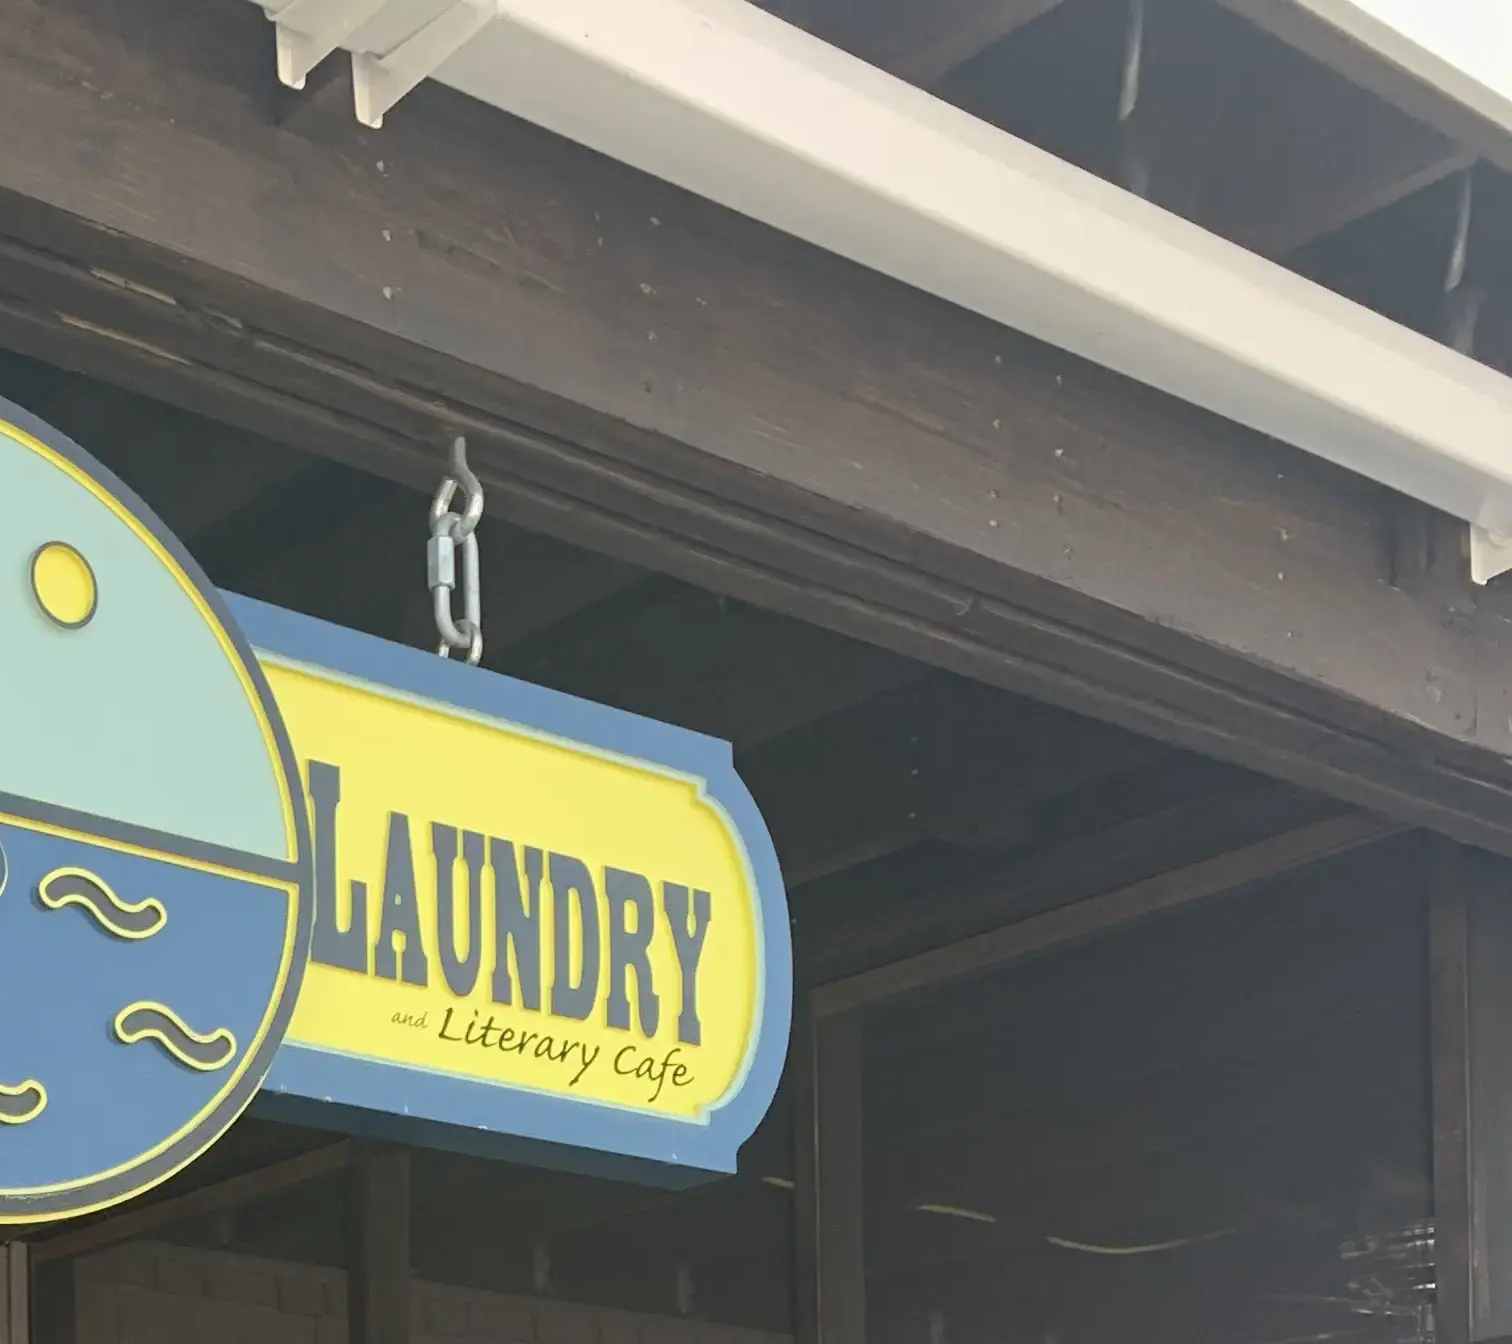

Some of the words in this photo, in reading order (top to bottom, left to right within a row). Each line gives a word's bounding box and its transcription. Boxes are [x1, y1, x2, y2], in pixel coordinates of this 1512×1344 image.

[306, 758, 712, 1047] LAUNDRY
[390, 1010, 429, 1030] and
[438, 1006, 601, 1087] Literary
[613, 1045, 696, 1103] Cafe
